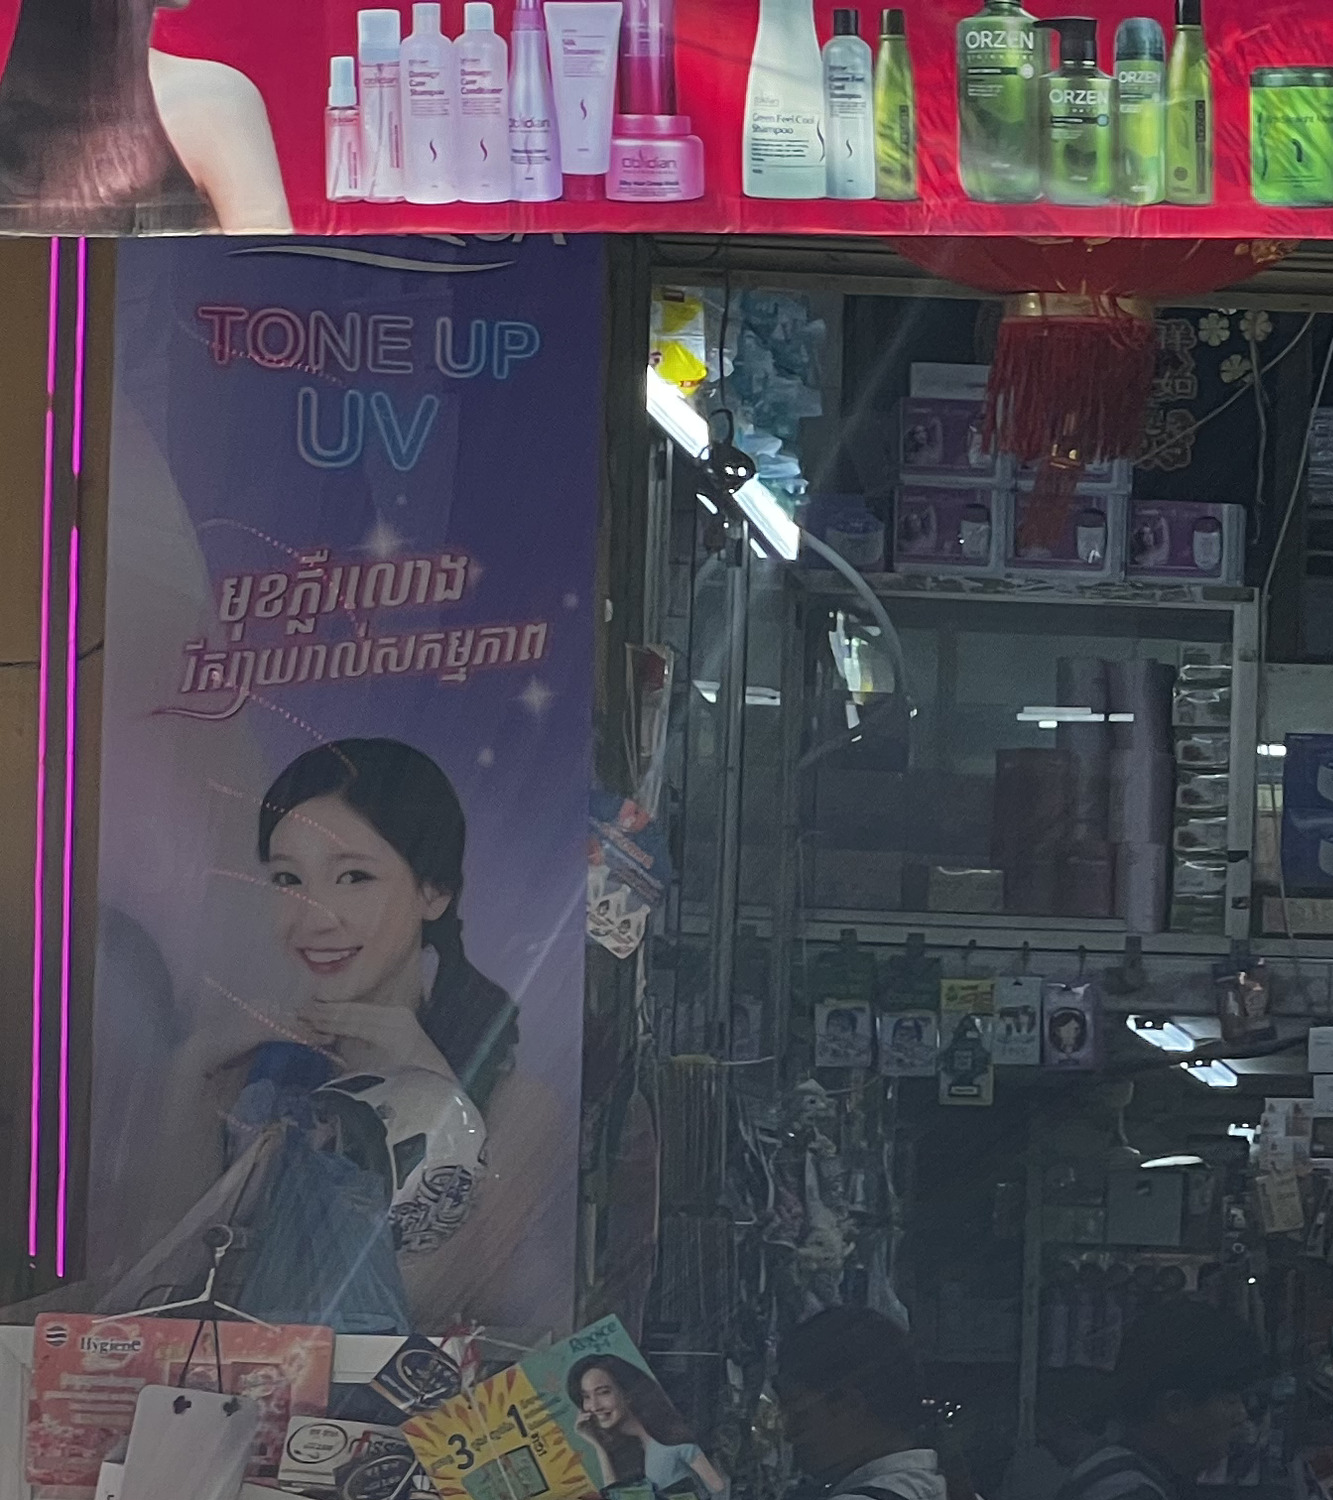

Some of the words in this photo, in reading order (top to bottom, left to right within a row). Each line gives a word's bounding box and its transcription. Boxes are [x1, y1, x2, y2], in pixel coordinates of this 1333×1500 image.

[965, 31, 1034, 50] ORZEN
[1119, 70, 1161, 84] ORZEN
[1049, 89, 1108, 106] ORZEN
[752, 125, 793, 136] Shampoo
[1293, 140, 1303, 162] 1
[199, 306, 413, 375] TONE
[435, 316, 541, 380] UP
[298, 389, 442, 471] UV
[80, 1336, 141, 1353] Hygiene
[448, 1434, 474, 1469] 3
[507, 1404, 528, 1438] 1
